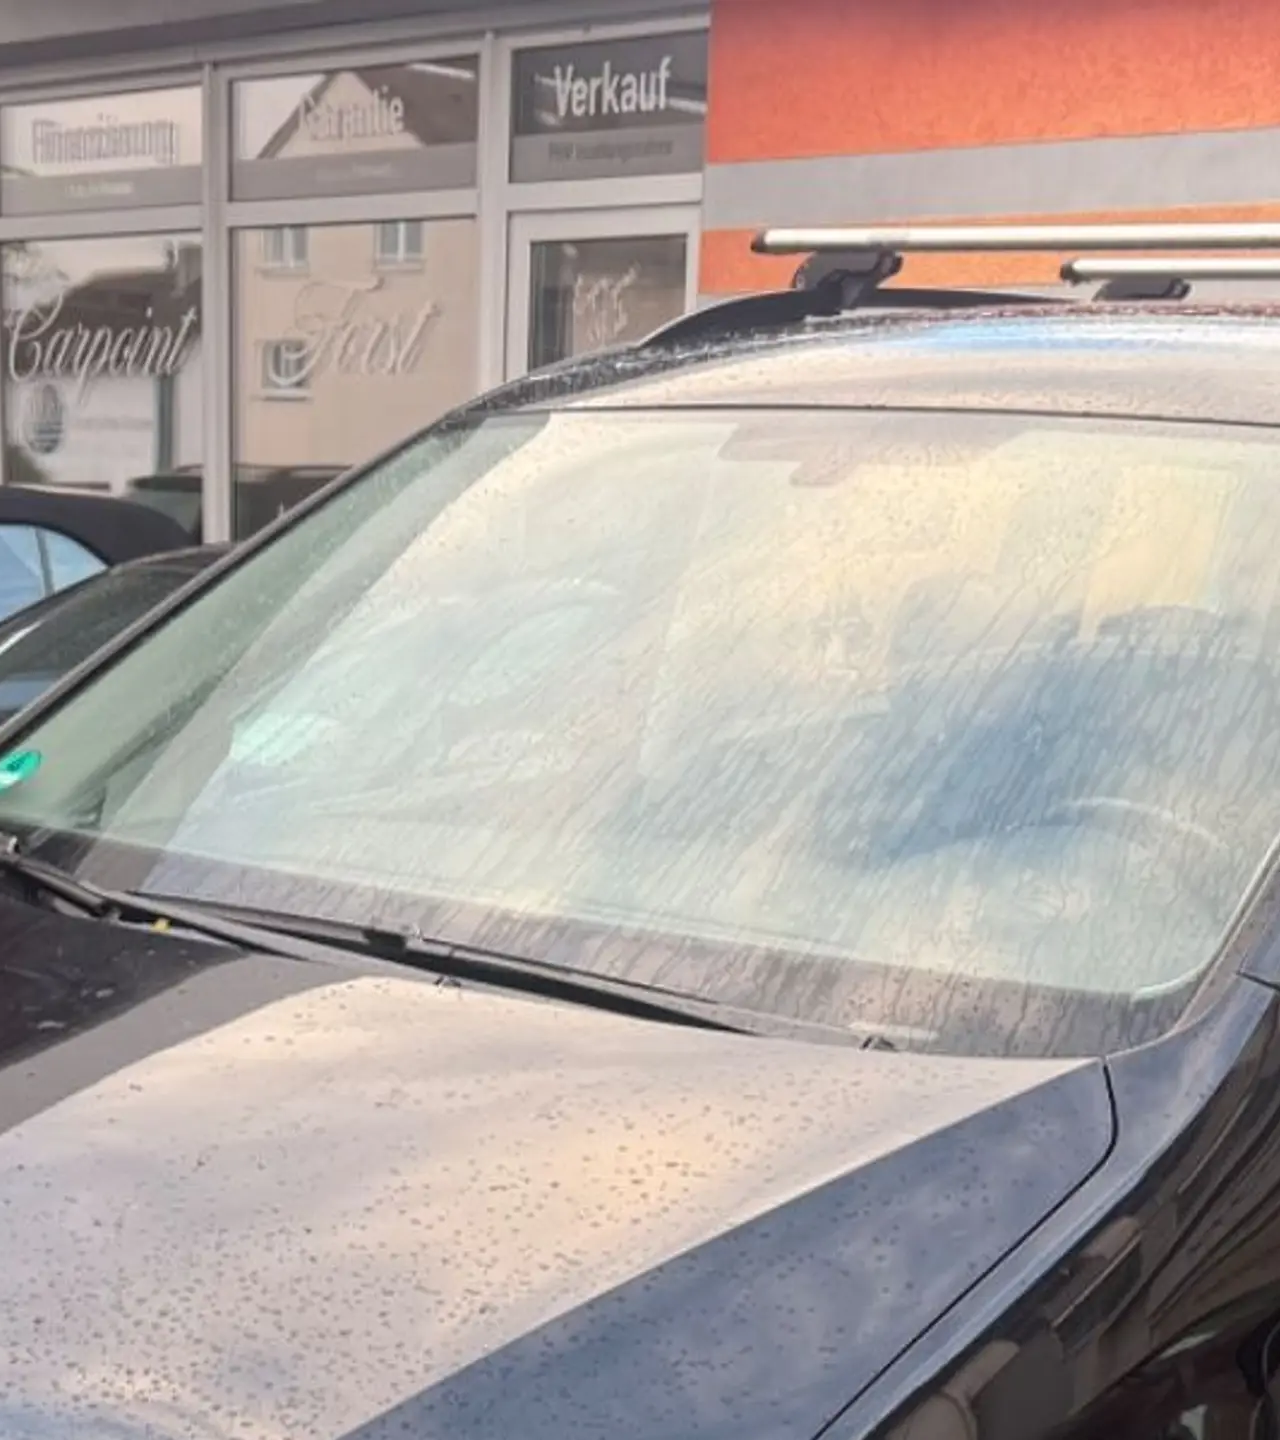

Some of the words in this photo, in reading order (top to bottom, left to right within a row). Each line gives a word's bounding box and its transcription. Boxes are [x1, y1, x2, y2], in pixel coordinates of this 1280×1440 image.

[554, 56, 673, 117] Verkauf
[4, 294, 199, 402] Carpoint
[267, 276, 441, 386] Forst
